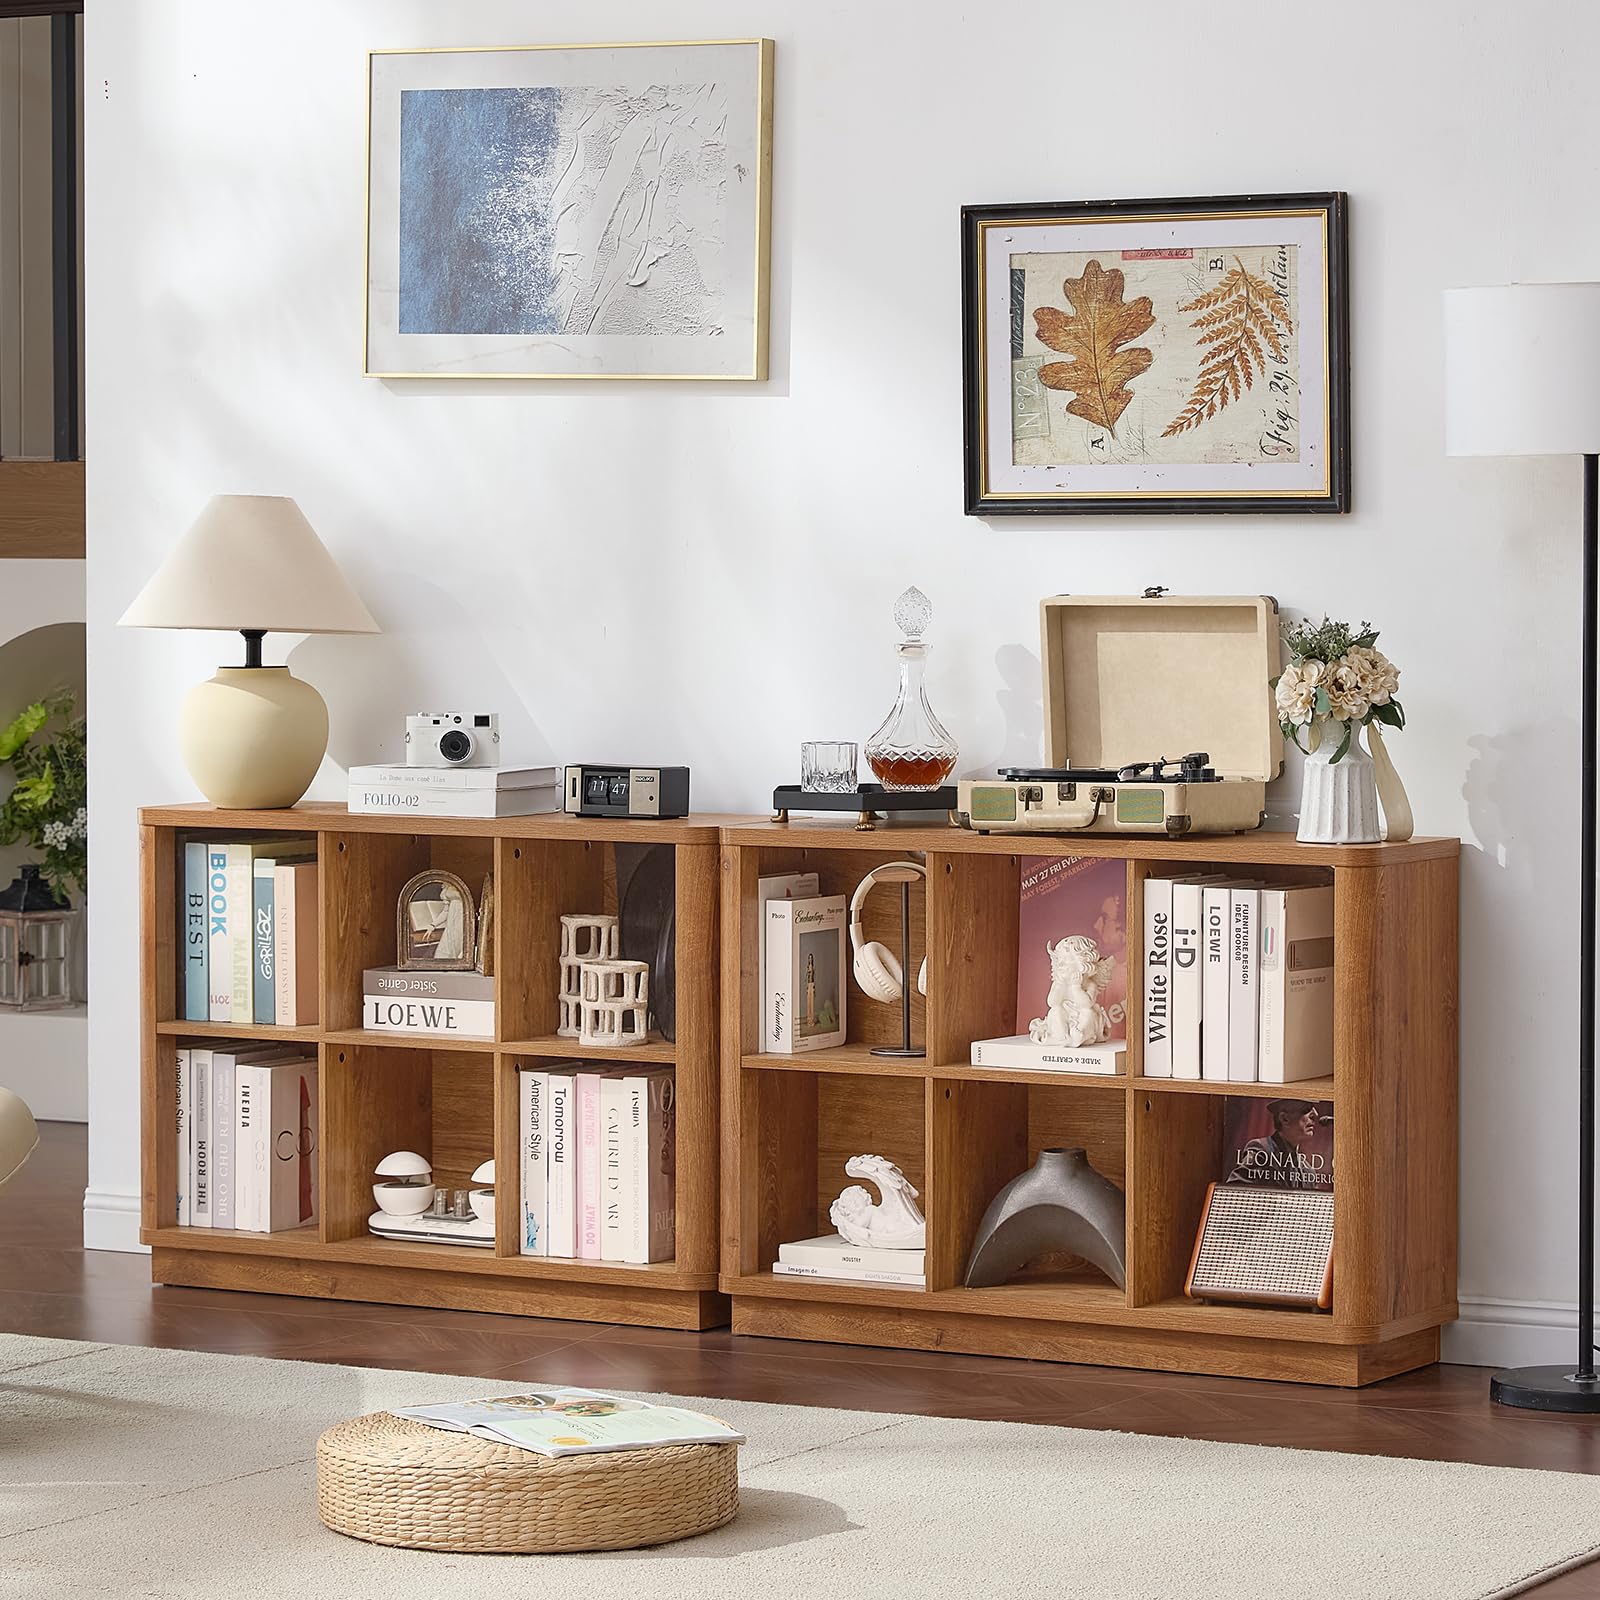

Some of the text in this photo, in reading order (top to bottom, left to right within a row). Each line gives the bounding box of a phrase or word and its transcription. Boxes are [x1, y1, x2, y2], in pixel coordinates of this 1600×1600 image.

[364, 792, 419, 808] FOLIO-02
[593, 780, 604, 792] 11
[612, 784, 626, 795] 47
[1022, 875, 1039, 890] MAY
[1040, 868, 1050, 882] 27
[1050, 862, 1062, 876] FRI
[1060, 858, 1096, 881] SPARKLING
[210, 854, 227, 936] BOOK
[189, 893, 204, 966] BEST
[1210, 906, 1221, 963] LOEWE
[1175, 929, 1197, 968] i-D
[378, 978, 438, 994] Sister Carrie
[1149, 912, 1168, 1044] White Rose
[374, 1002, 458, 1029] LOEWE
[1042, 1056, 1074, 1064] CRAFTED
[242, 1086, 250, 1128] INEDIA
[530, 1078, 542, 1161] American Style
[632, 1090, 640, 1128] FASHION
[554, 1088, 567, 1163] Tomorrow
[198, 1140, 206, 1206] THE ROOM
[1236, 1150, 1324, 1170] LEONARD
[1248, 1169, 1270, 1180] LIVE
[1274, 1170, 1286, 1182] IN
[586, 1205, 596, 1230] WHAT
[608, 1202, 619, 1230] ART
[586, 1232, 596, 1245] DO
